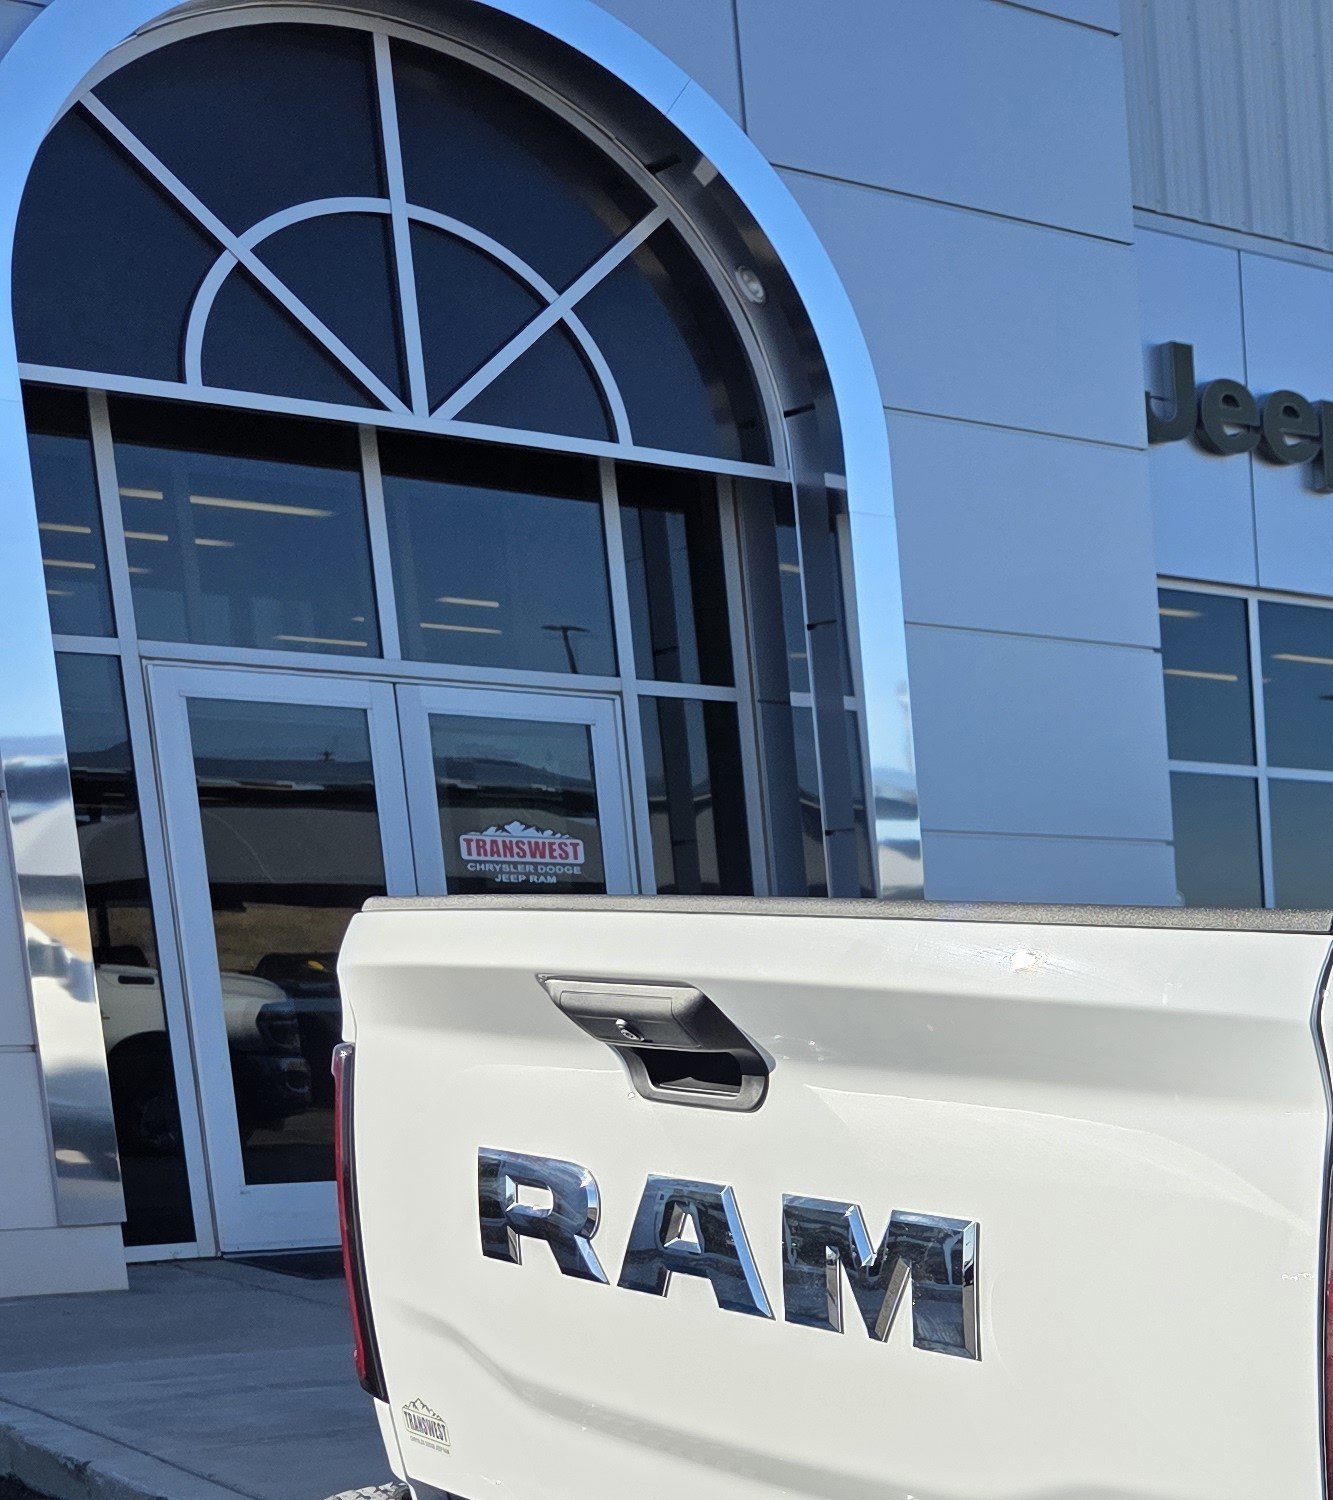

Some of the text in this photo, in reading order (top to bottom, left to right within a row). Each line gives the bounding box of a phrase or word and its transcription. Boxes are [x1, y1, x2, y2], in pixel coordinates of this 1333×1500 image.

[462, 838, 580, 861] TRANSWEST
[467, 862, 582, 875] CHRYSLER DODGE
[494, 874, 557, 884] JEEP RAM
[477, 1146, 983, 1362] RAM
[403, 1410, 448, 1443] TRANSWEST
